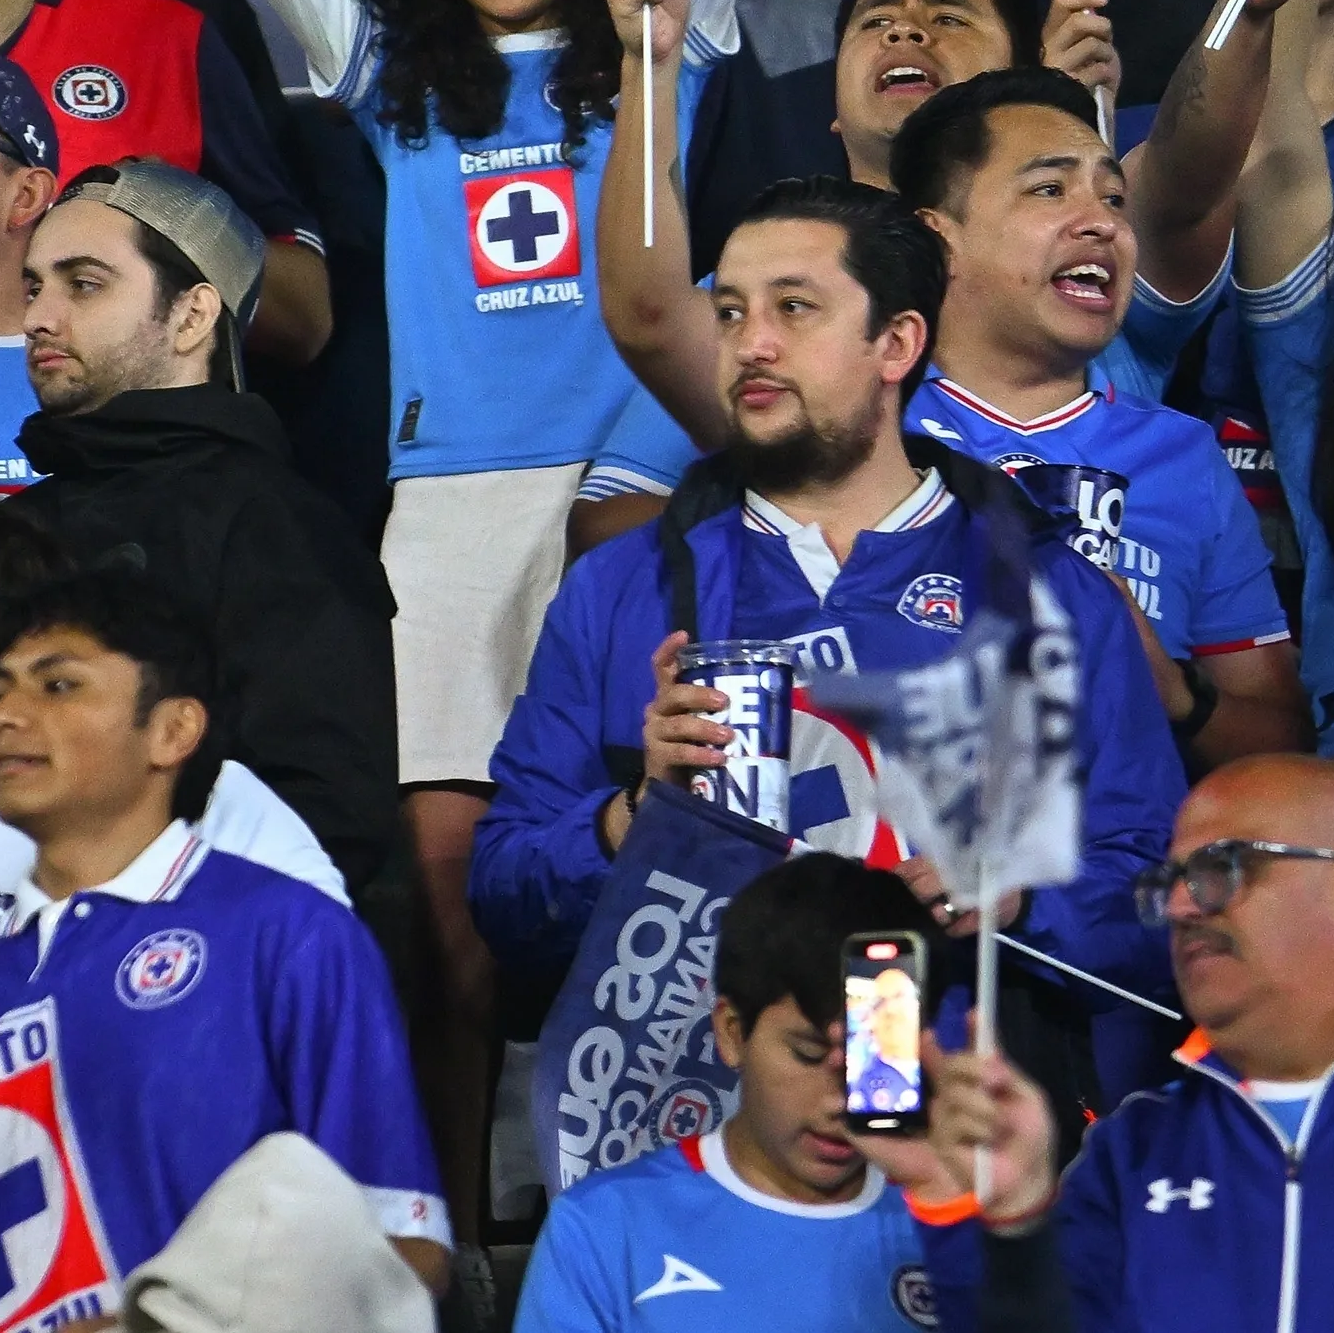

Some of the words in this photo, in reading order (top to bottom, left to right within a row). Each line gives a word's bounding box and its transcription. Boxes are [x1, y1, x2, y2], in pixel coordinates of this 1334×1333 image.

[474, 286, 530, 313] CRUZ
[530, 280, 585, 308] AZUL
[1077, 480, 1125, 539] LO
